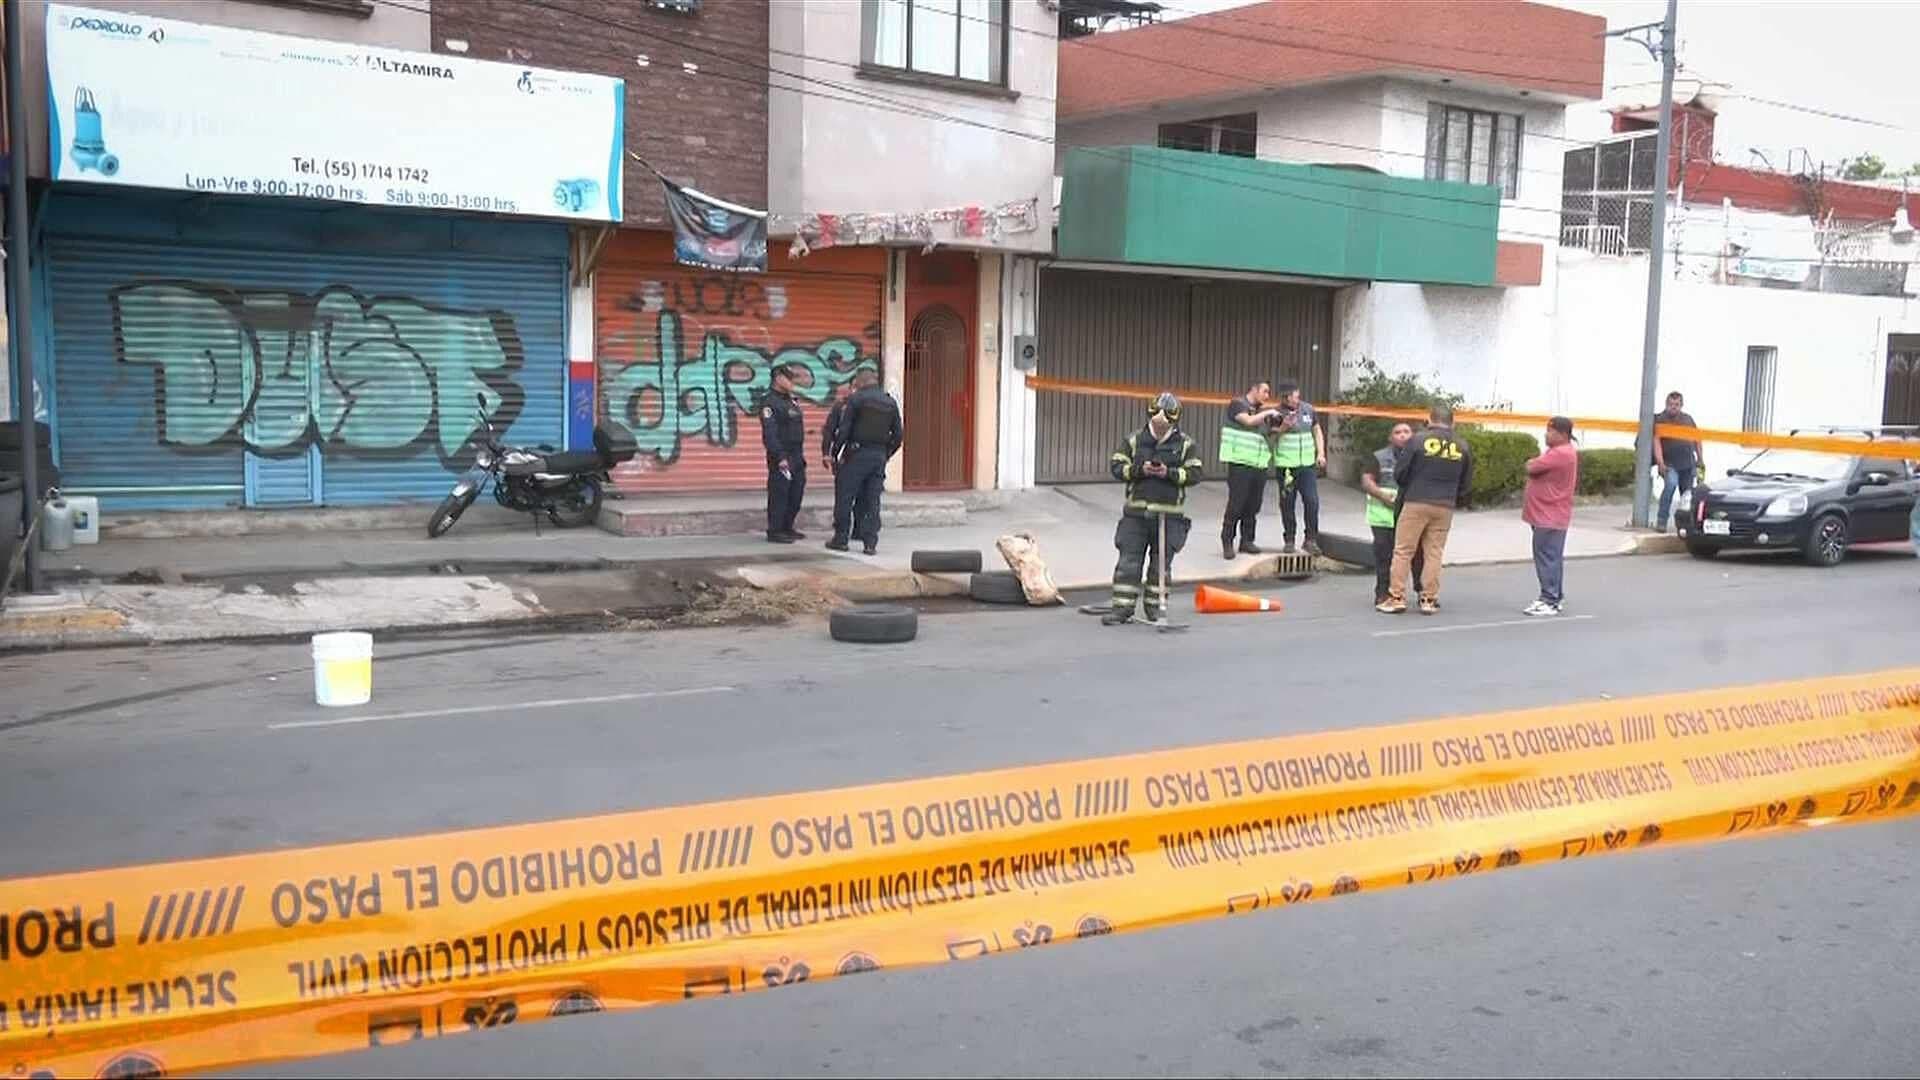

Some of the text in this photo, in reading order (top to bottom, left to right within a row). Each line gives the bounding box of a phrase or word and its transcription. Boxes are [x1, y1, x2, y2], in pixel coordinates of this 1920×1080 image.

[365, 55, 455, 80] ALTAMIRA
[184, 172, 248, 192] Lun-Vie
[339, 185, 368, 201] hrs.
[292, 157, 429, 184] Tel. (55) 1714 1742
[494, 195, 521, 212] hrs.
[1663, 697, 1814, 738] PROHIBIDO EL PASO
[1432, 720, 1615, 768] PROHIBIDO EL PASO
[1145, 750, 1372, 808] PROHIBIDO EL PASO
[1567, 774, 1588, 804] DE
[769, 787, 1063, 859] PROHIBIDO EL PASO
[1335, 799, 1410, 842] RIESGOS
[1410, 797, 1433, 828] DE
[1431, 784, 1507, 823] INTEGRAL
[1322, 810, 1342, 843] Y
[1010, 839, 1135, 896] SECRETARÍA
[1158, 829, 1209, 869] CIVIL
[271, 837, 663, 928] PROHIBIDO EL PASO
[878, 862, 976, 915] GESTIÓN
[980, 857, 1011, 896] DE
[718, 896, 751, 935] DE
[756, 876, 873, 932] INTEGRAL
[576, 920, 589, 960] Y
[597, 902, 712, 952] RIESGOS
[288, 953, 369, 998] CIVIL
